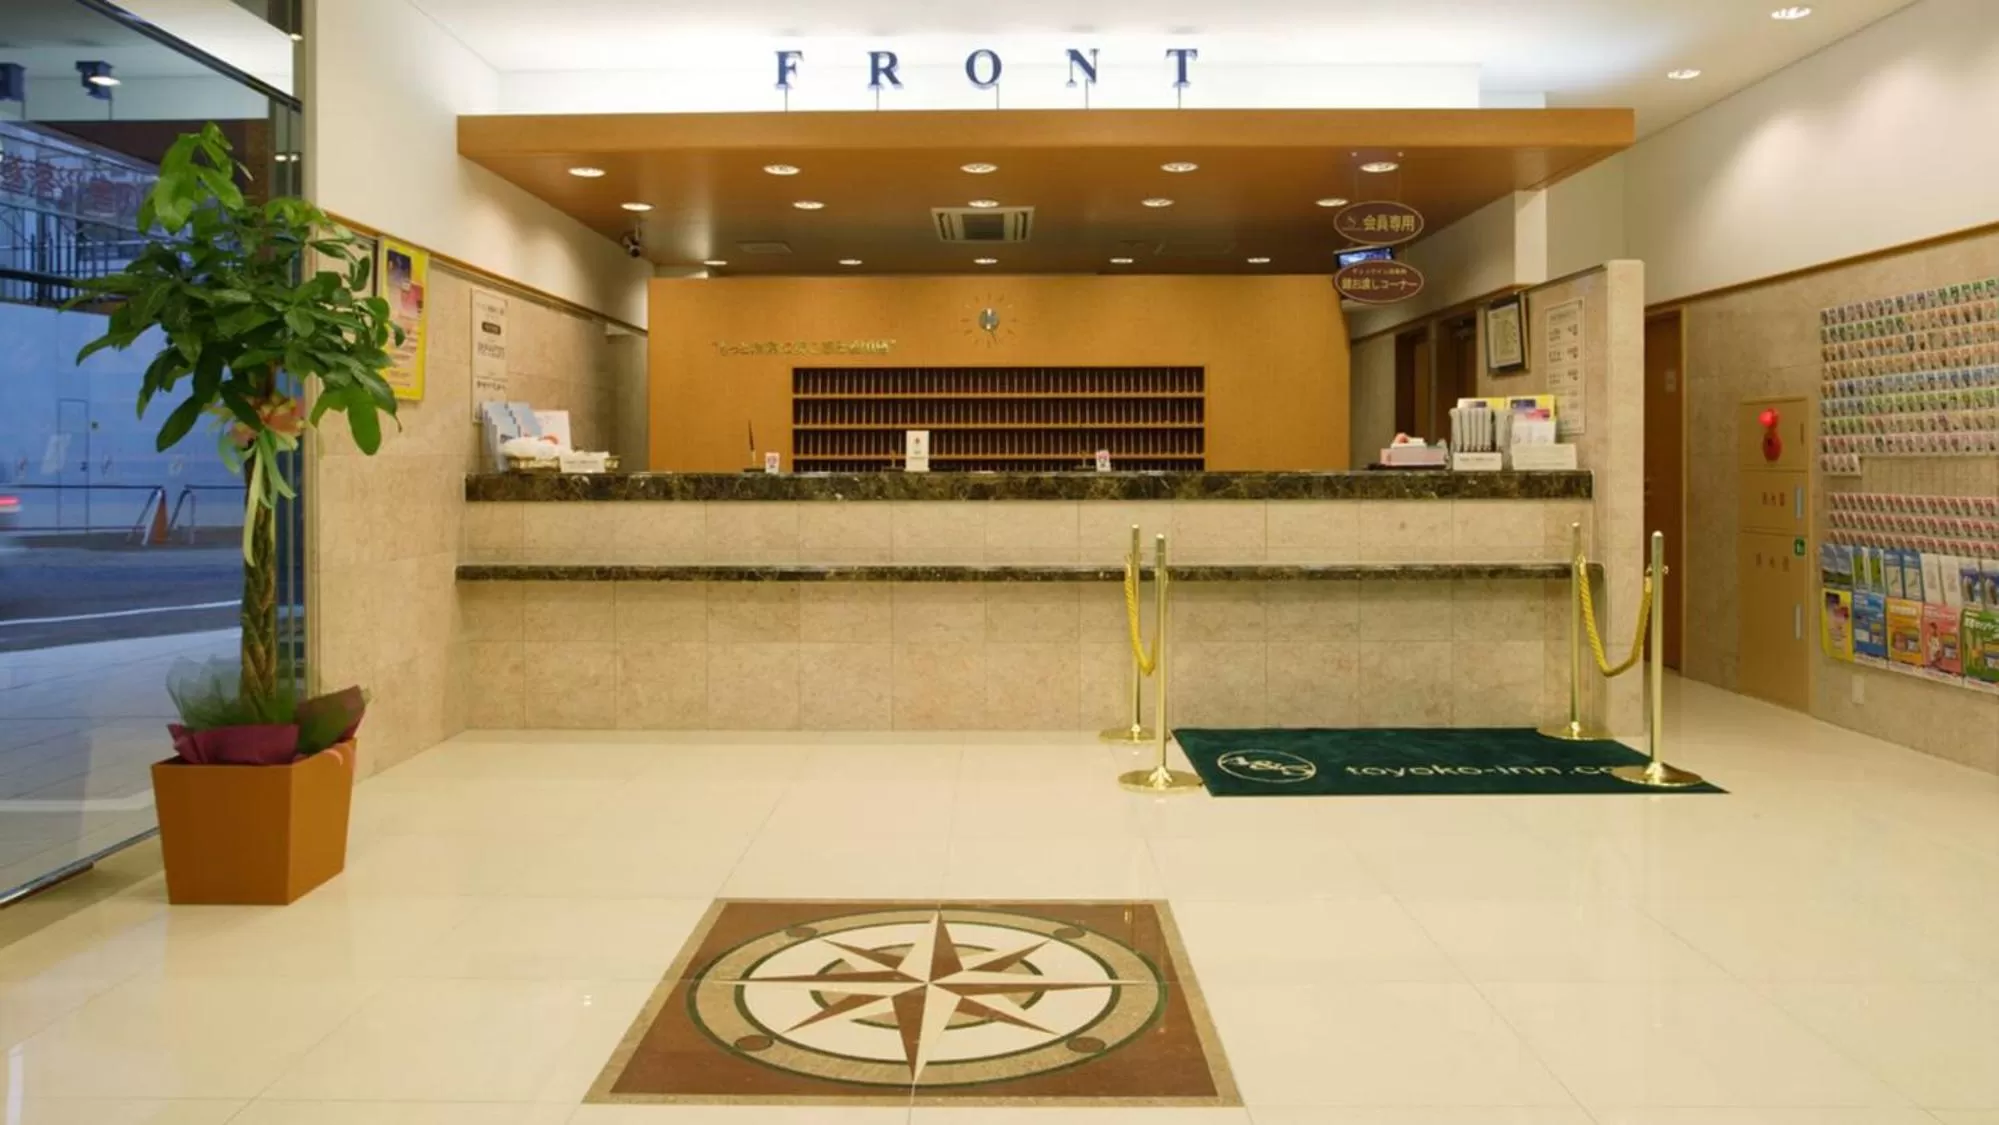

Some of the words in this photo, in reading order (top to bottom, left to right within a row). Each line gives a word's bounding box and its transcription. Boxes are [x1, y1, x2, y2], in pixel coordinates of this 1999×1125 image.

[774, 48, 1199, 89] FRONT
[1363, 214, 1415, 232] 会員専用
